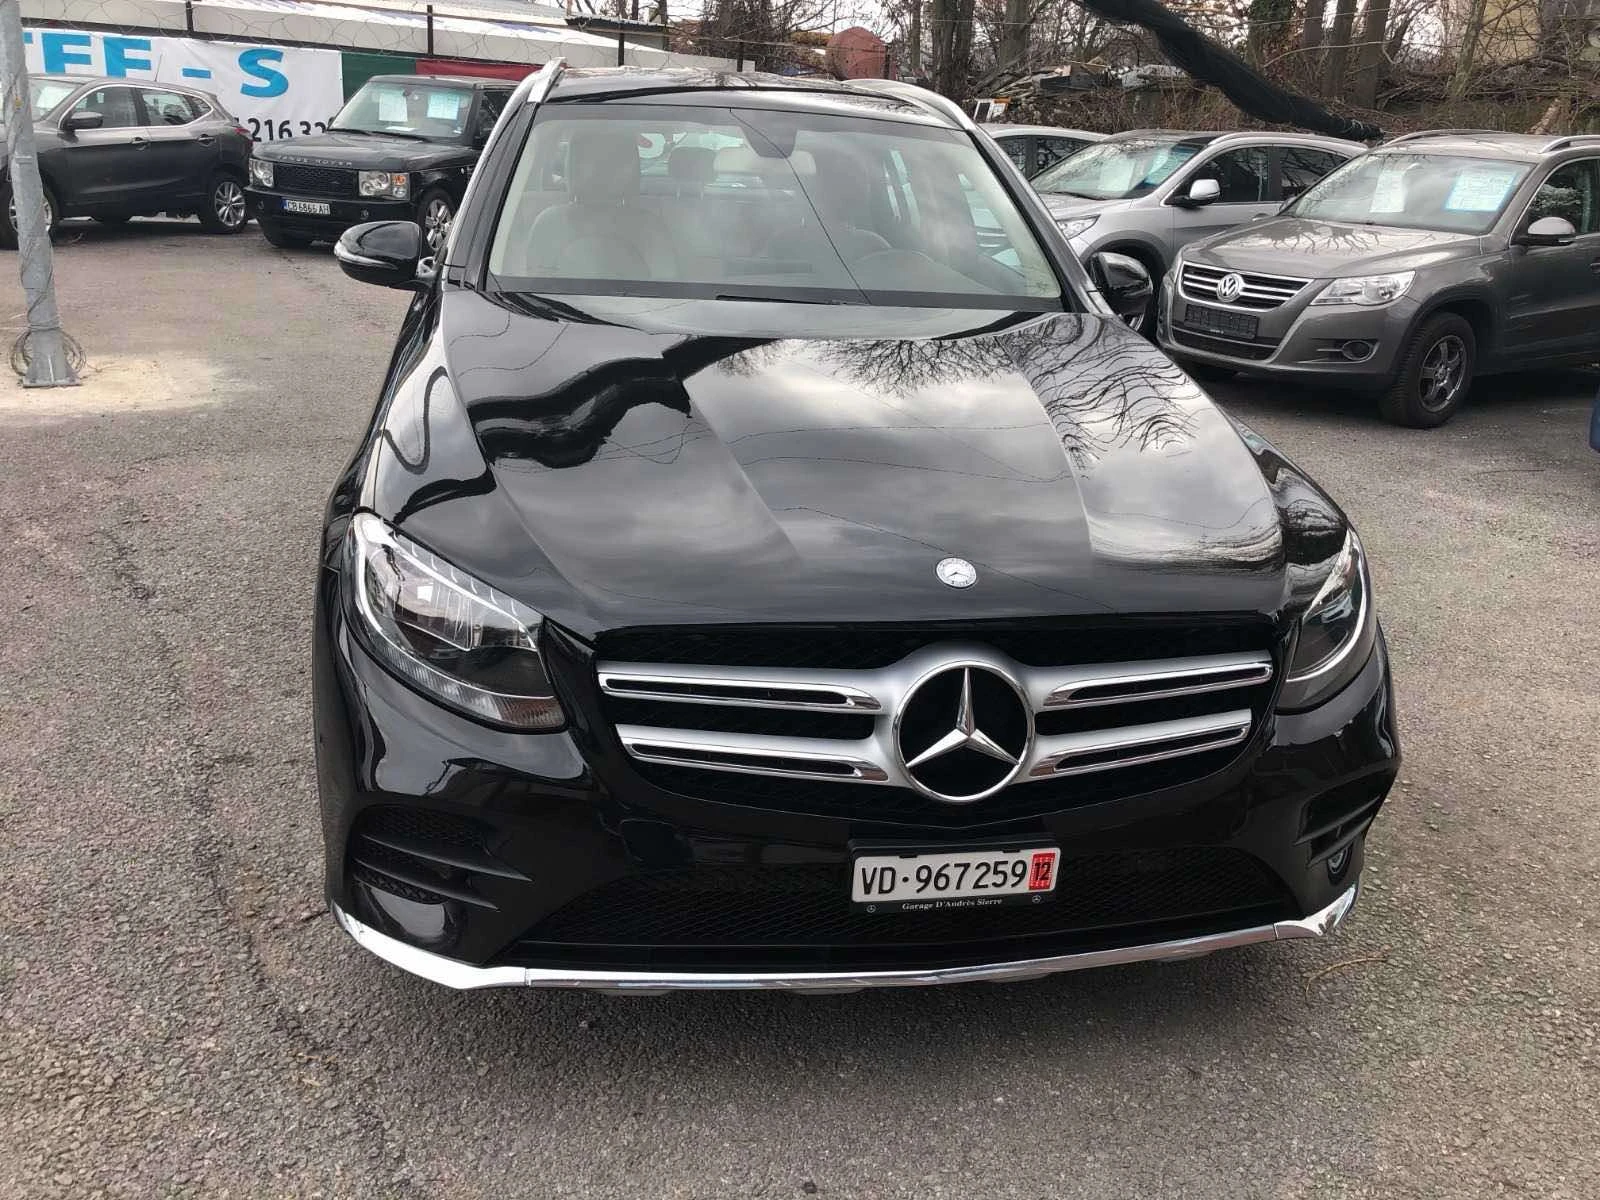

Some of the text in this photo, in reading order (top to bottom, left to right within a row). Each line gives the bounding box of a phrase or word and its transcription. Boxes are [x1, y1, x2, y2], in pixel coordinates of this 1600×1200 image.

[238, 48, 289, 98] S
[1034, 861, 1051, 881] 12
[901, 902, 934, 910] Garage
